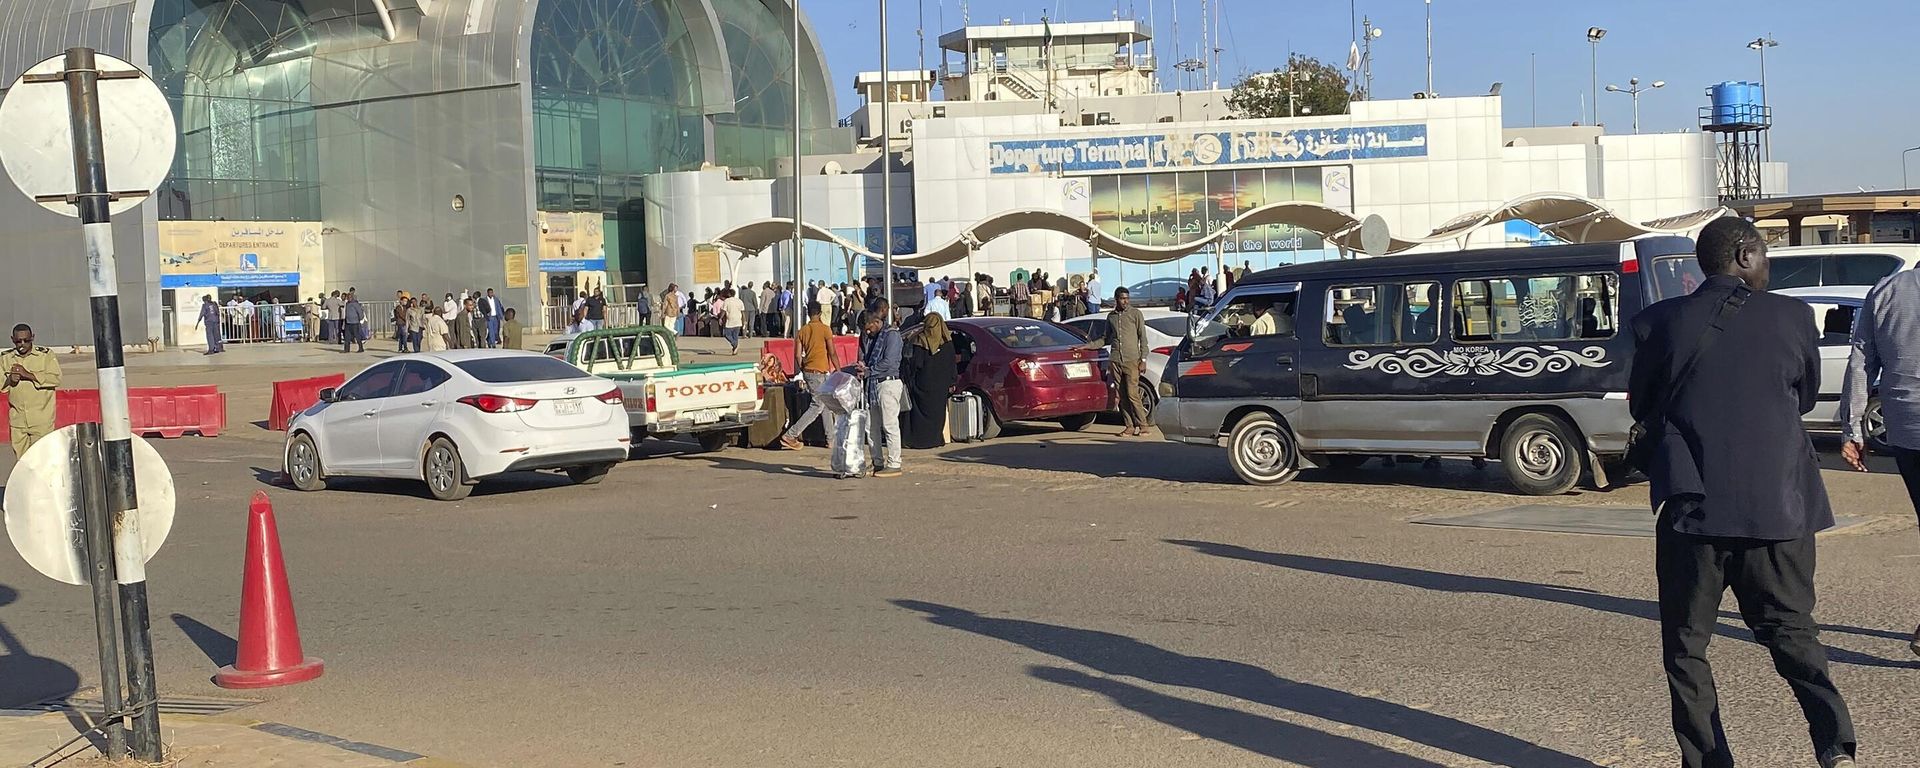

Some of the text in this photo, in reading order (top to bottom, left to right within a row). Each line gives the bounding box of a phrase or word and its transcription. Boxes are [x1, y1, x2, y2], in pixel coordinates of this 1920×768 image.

[992, 144, 1075, 170] Departure
[1077, 137, 1149, 163] Terminal
[1123, 221, 1165, 241] العالم
[219, 241, 279, 249] DEPARTURES ENTRANCE
[1223, 240, 1235, 251] to
[1243, 239, 1262, 250] the
[1270, 237, 1303, 249] world
[665, 380, 749, 398] TOYOTA
